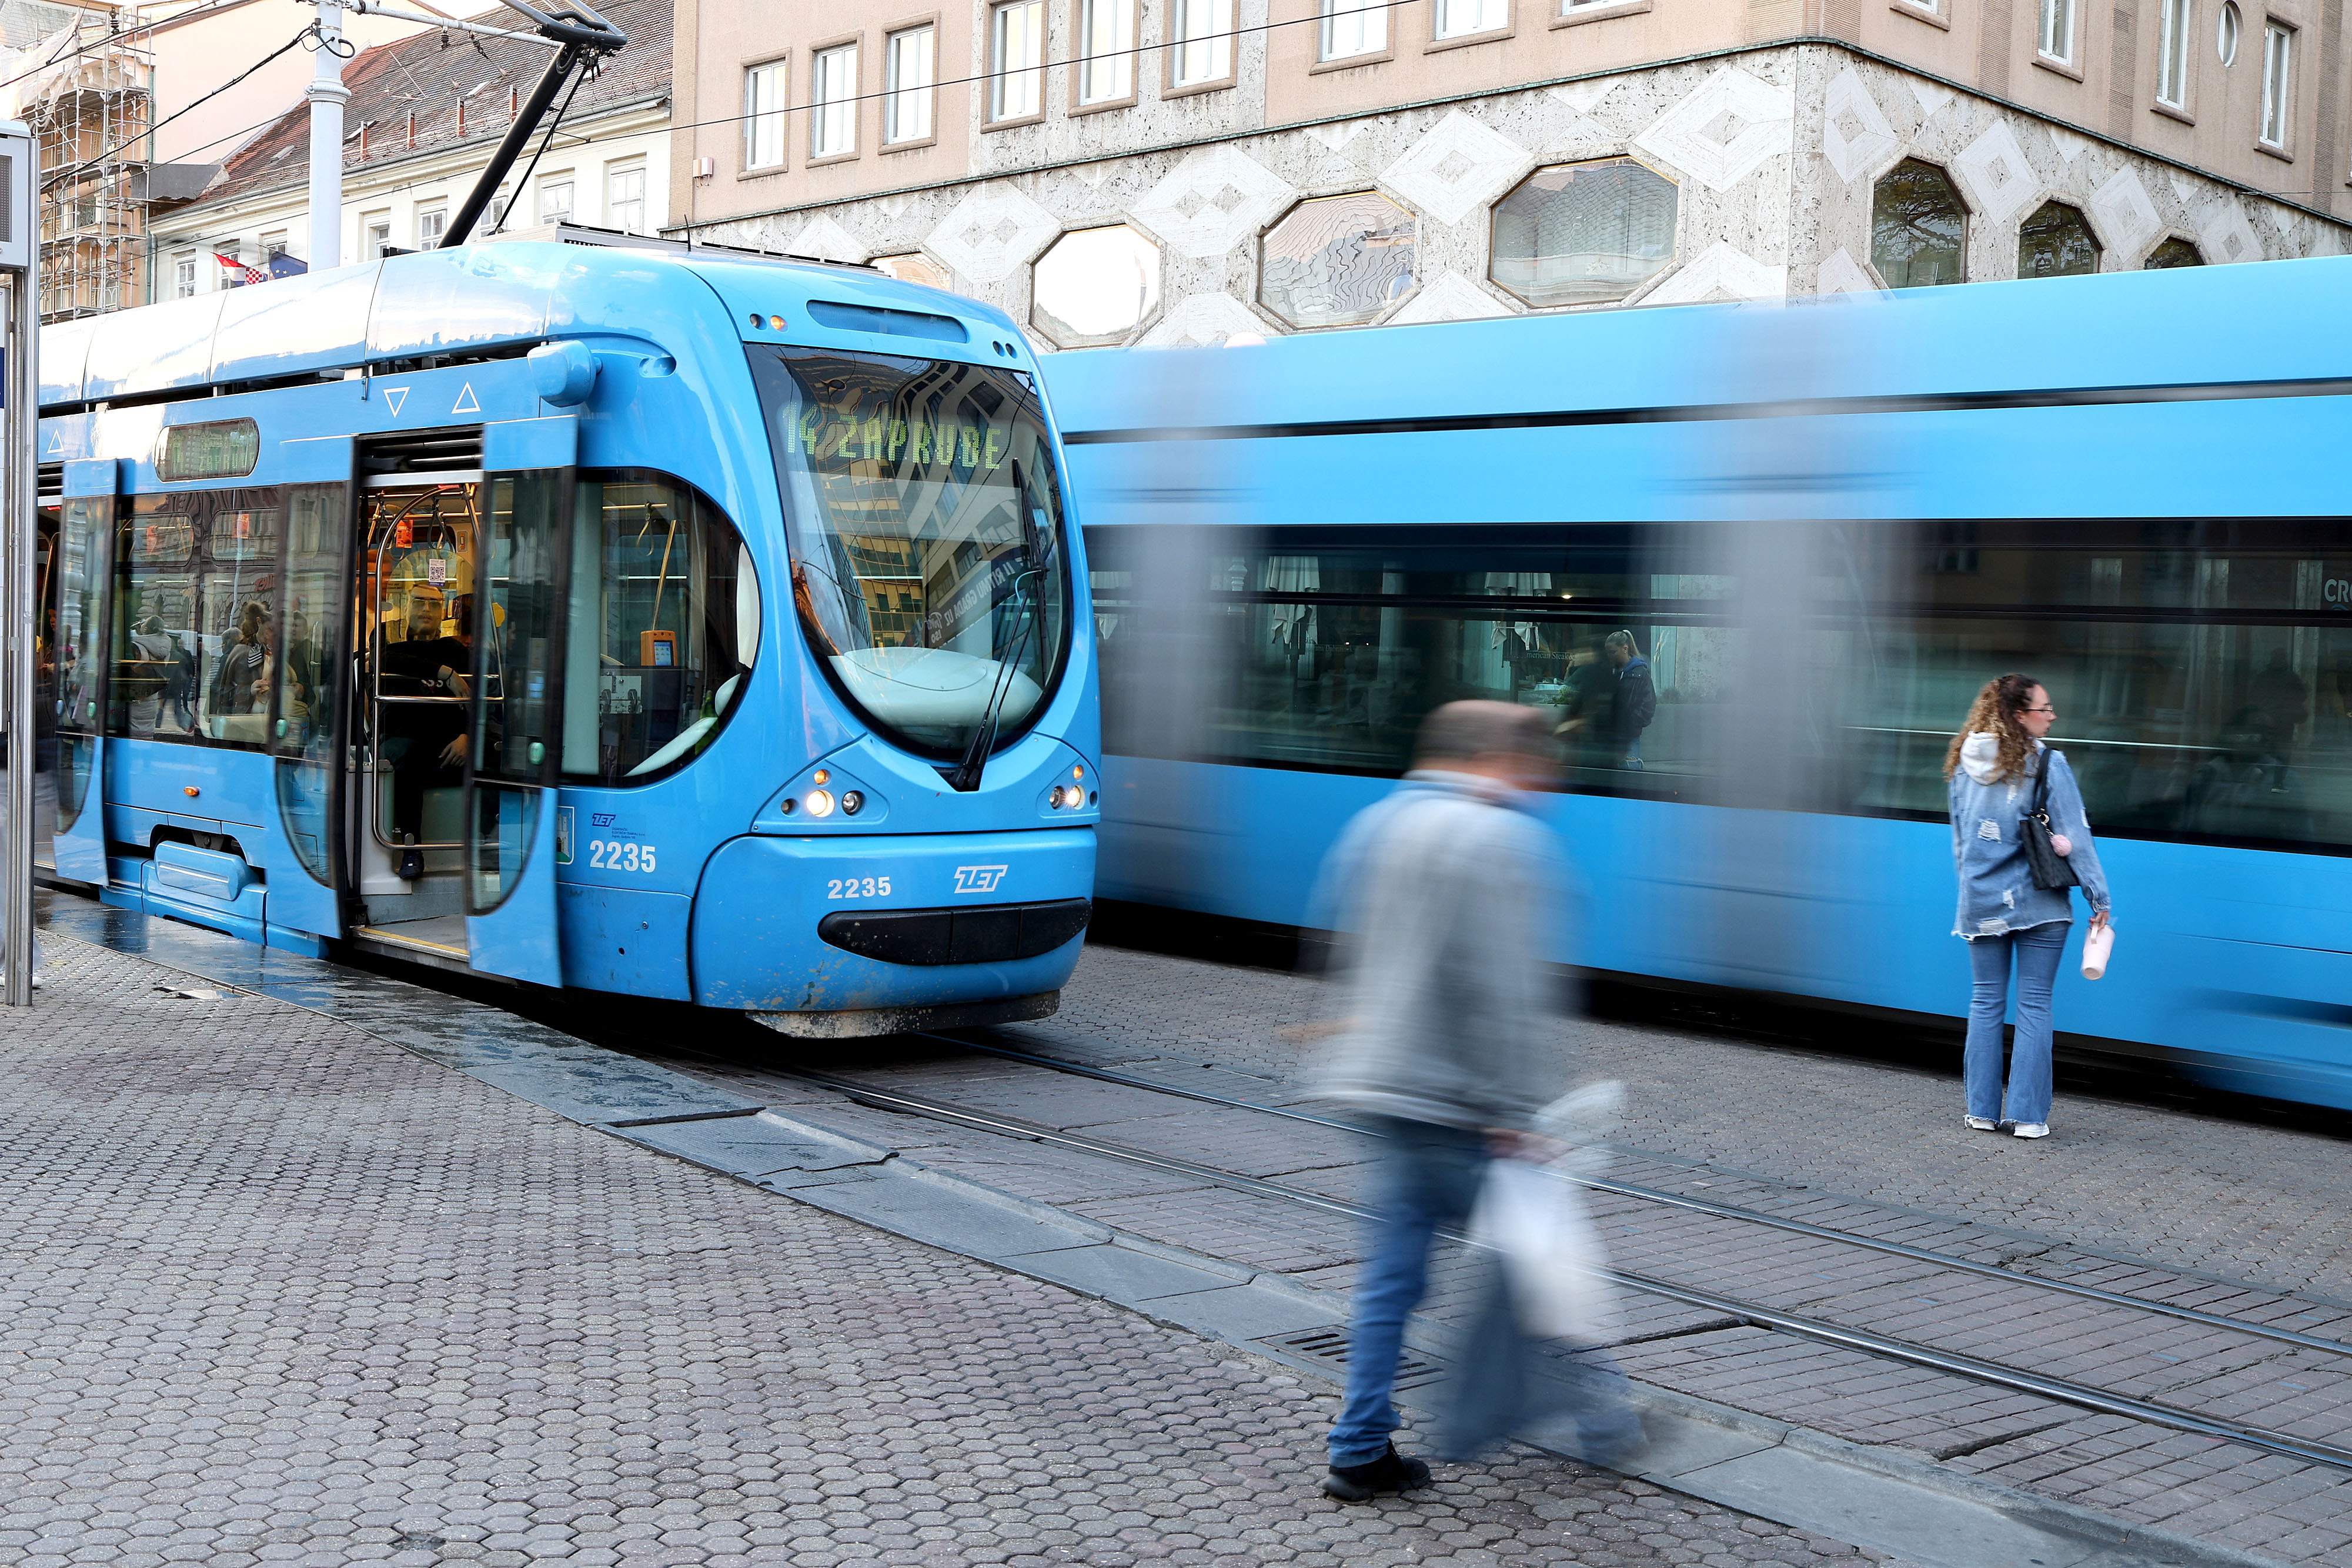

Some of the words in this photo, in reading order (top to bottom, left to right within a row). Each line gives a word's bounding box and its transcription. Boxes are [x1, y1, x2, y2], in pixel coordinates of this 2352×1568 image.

[783, 402, 817, 455] 14
[2324, 579, 2352, 603] CR
[592, 813, 616, 827] ZET
[589, 840, 656, 873] 2235
[827, 876, 892, 900] 2235
[954, 864, 1008, 894] ZET
